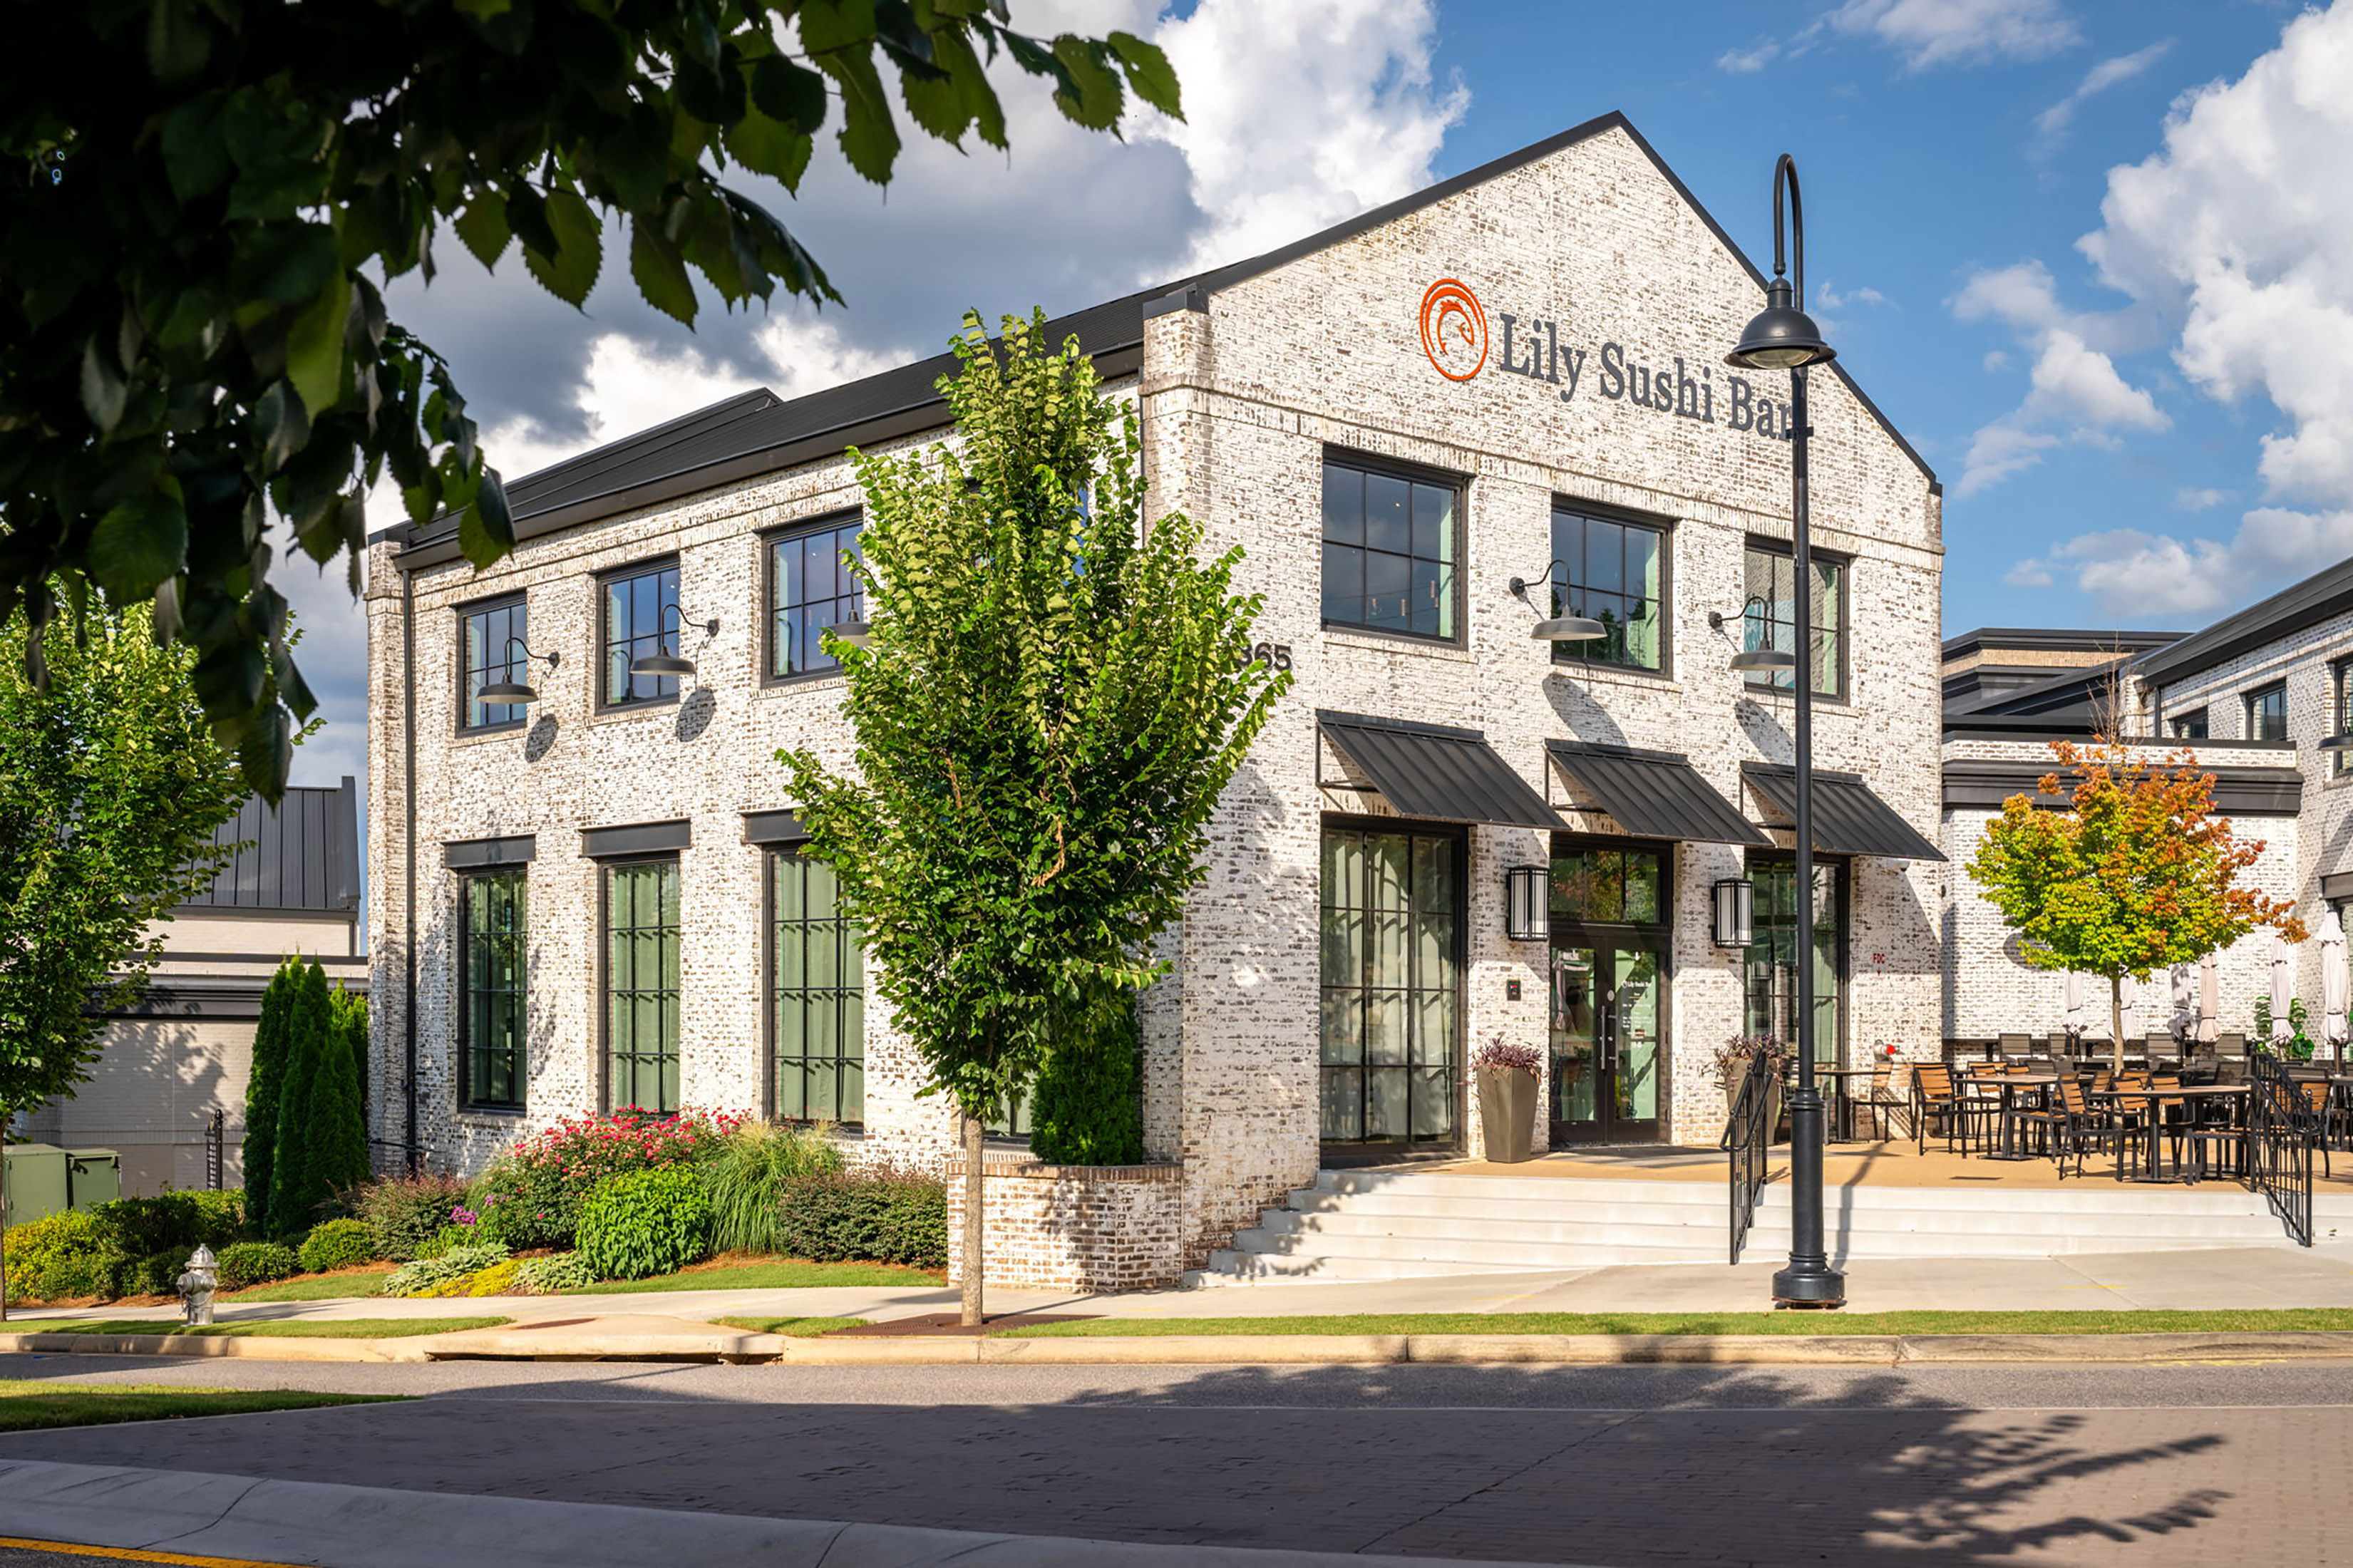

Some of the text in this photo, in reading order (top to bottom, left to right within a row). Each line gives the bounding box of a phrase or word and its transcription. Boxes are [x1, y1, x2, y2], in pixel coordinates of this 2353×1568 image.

[1500, 313, 1793, 443] Lily Sushi Bar
[1873, 953, 1885, 964] FDC
